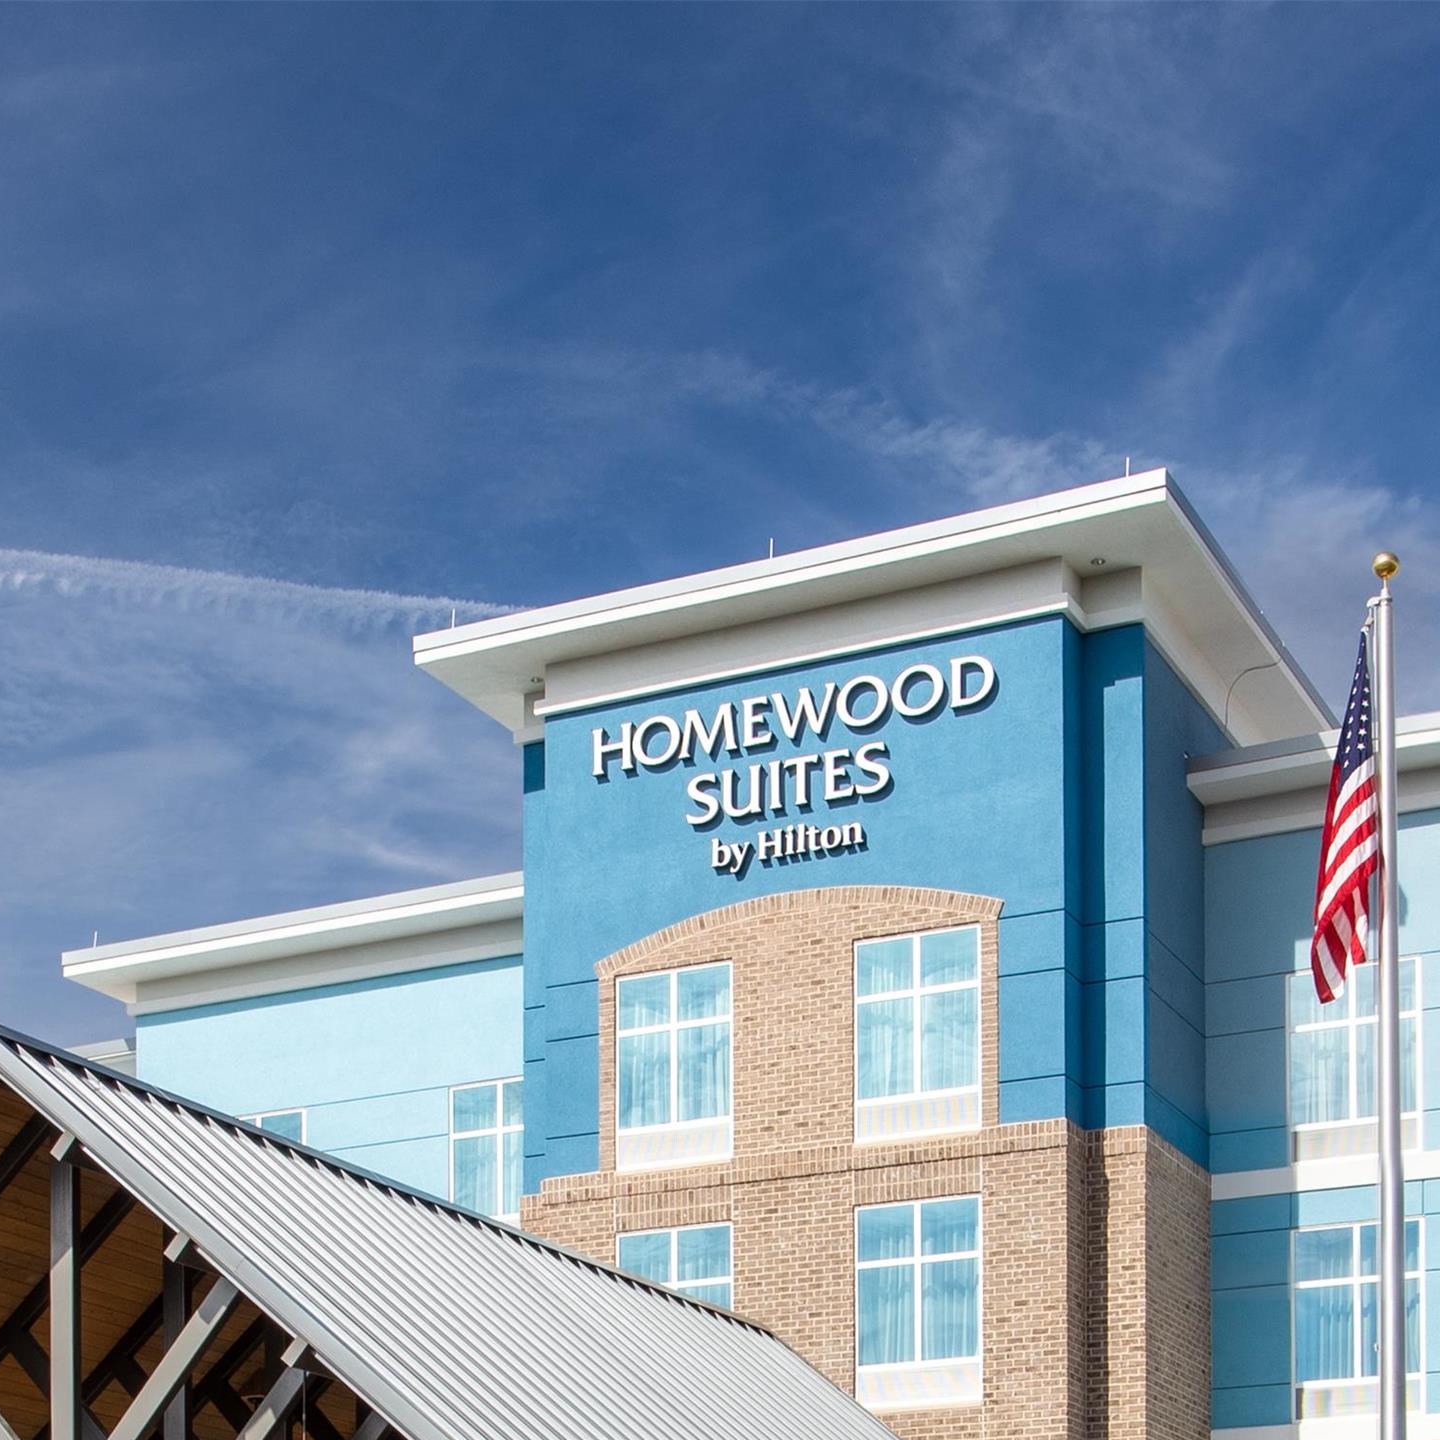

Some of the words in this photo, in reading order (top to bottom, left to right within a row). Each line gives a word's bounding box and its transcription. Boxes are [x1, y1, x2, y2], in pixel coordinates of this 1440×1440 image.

[591, 655, 995, 777] HOMEWOOD
[686, 741, 890, 825] SUITES
[711, 838, 751, 874] by
[757, 821, 864, 861] Hilton
